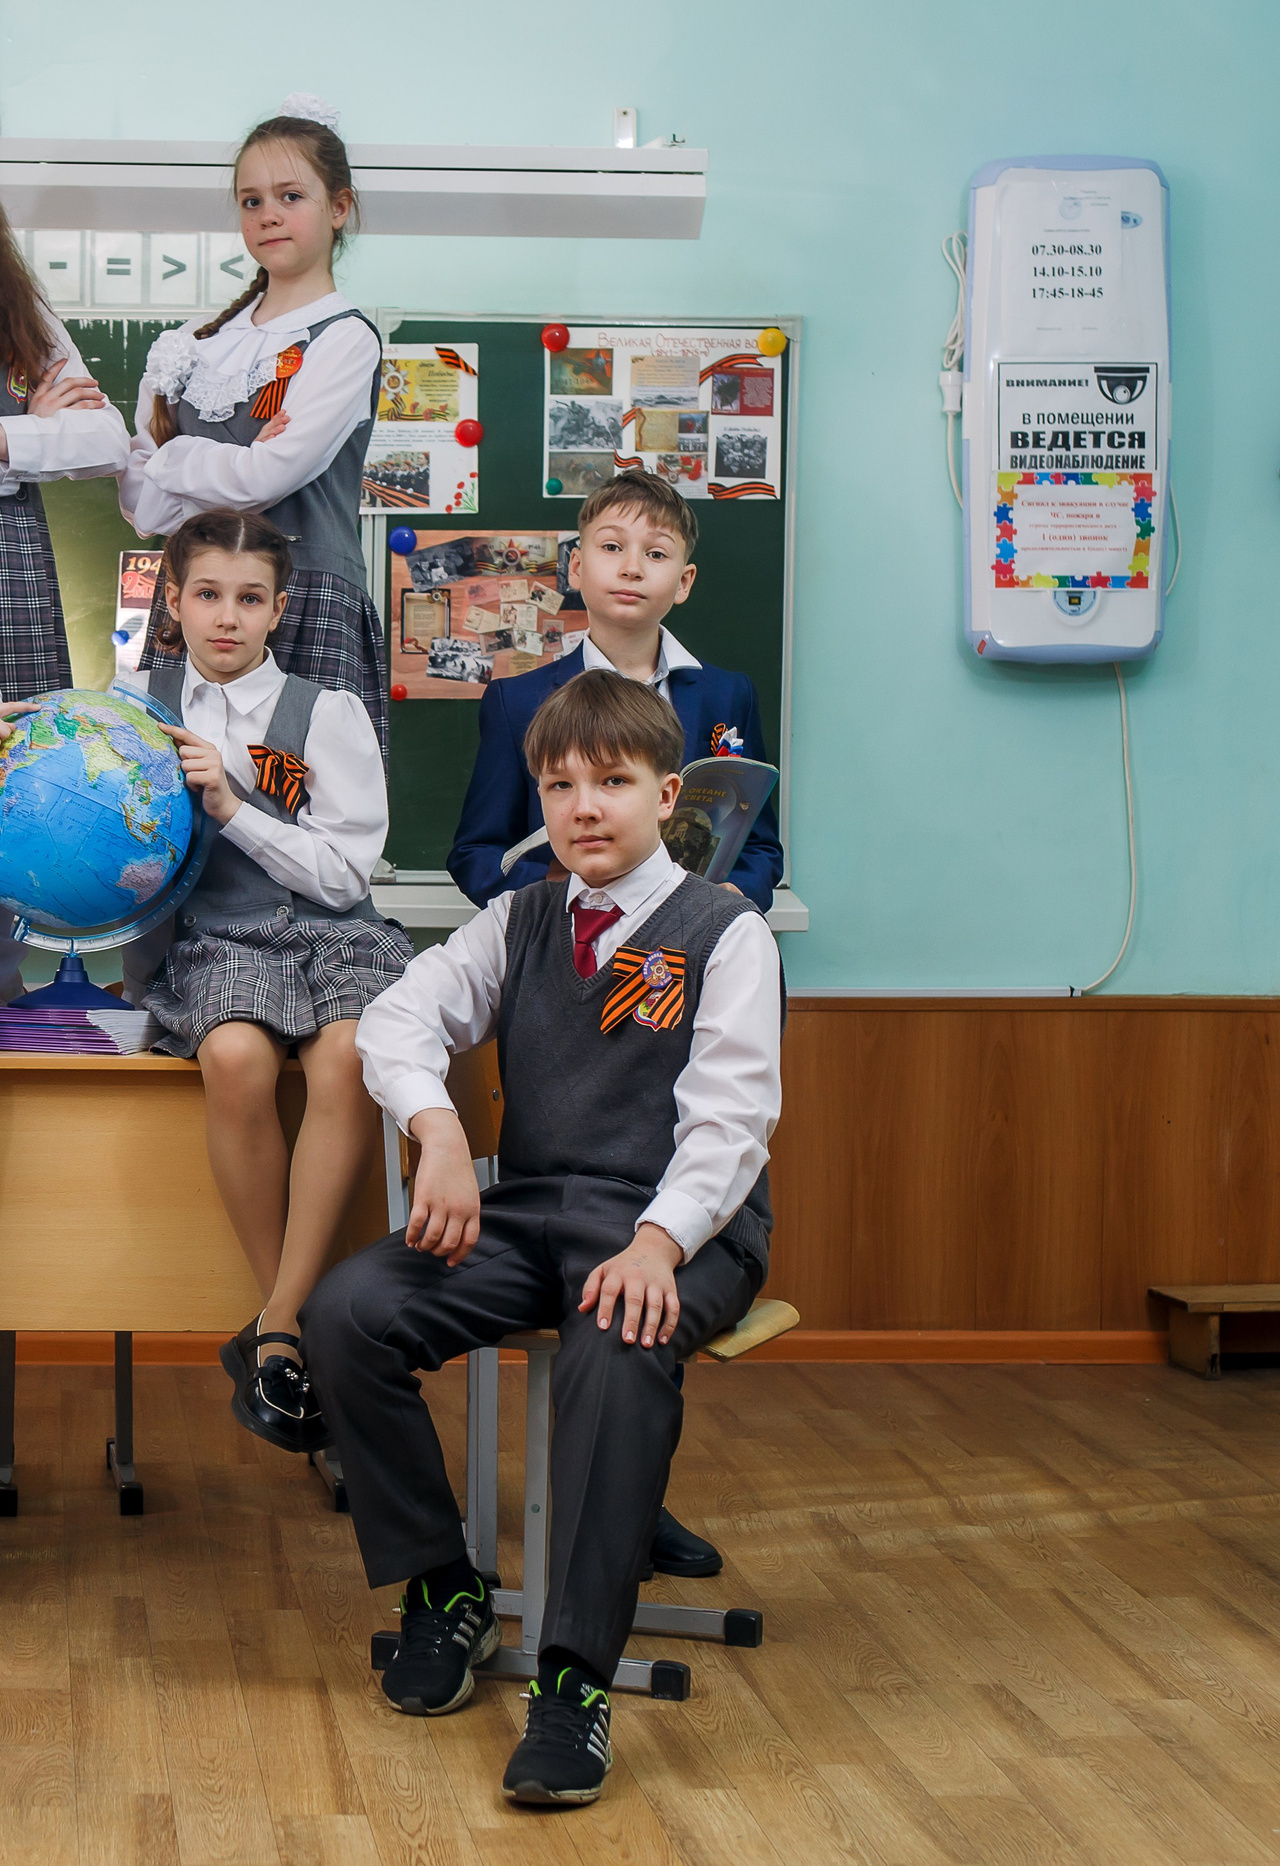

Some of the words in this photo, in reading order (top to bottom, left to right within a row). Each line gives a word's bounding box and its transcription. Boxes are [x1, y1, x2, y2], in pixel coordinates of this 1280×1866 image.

[1031, 244, 1102, 256] 07.30-08.30
[1033, 265, 1102, 277] 14.10-15.10
[1032, 287, 1104, 299] 17:45-18-45
[1005, 378, 1089, 388] ВНИМАНИЕ!
[1010, 430, 1146, 452] ВЕДЕТСЯ
[1009, 454, 1146, 470] ВИДЕОНАБЛЮДЕНИЕ
[688, 787, 727, 798] ОКЕАНЕ
